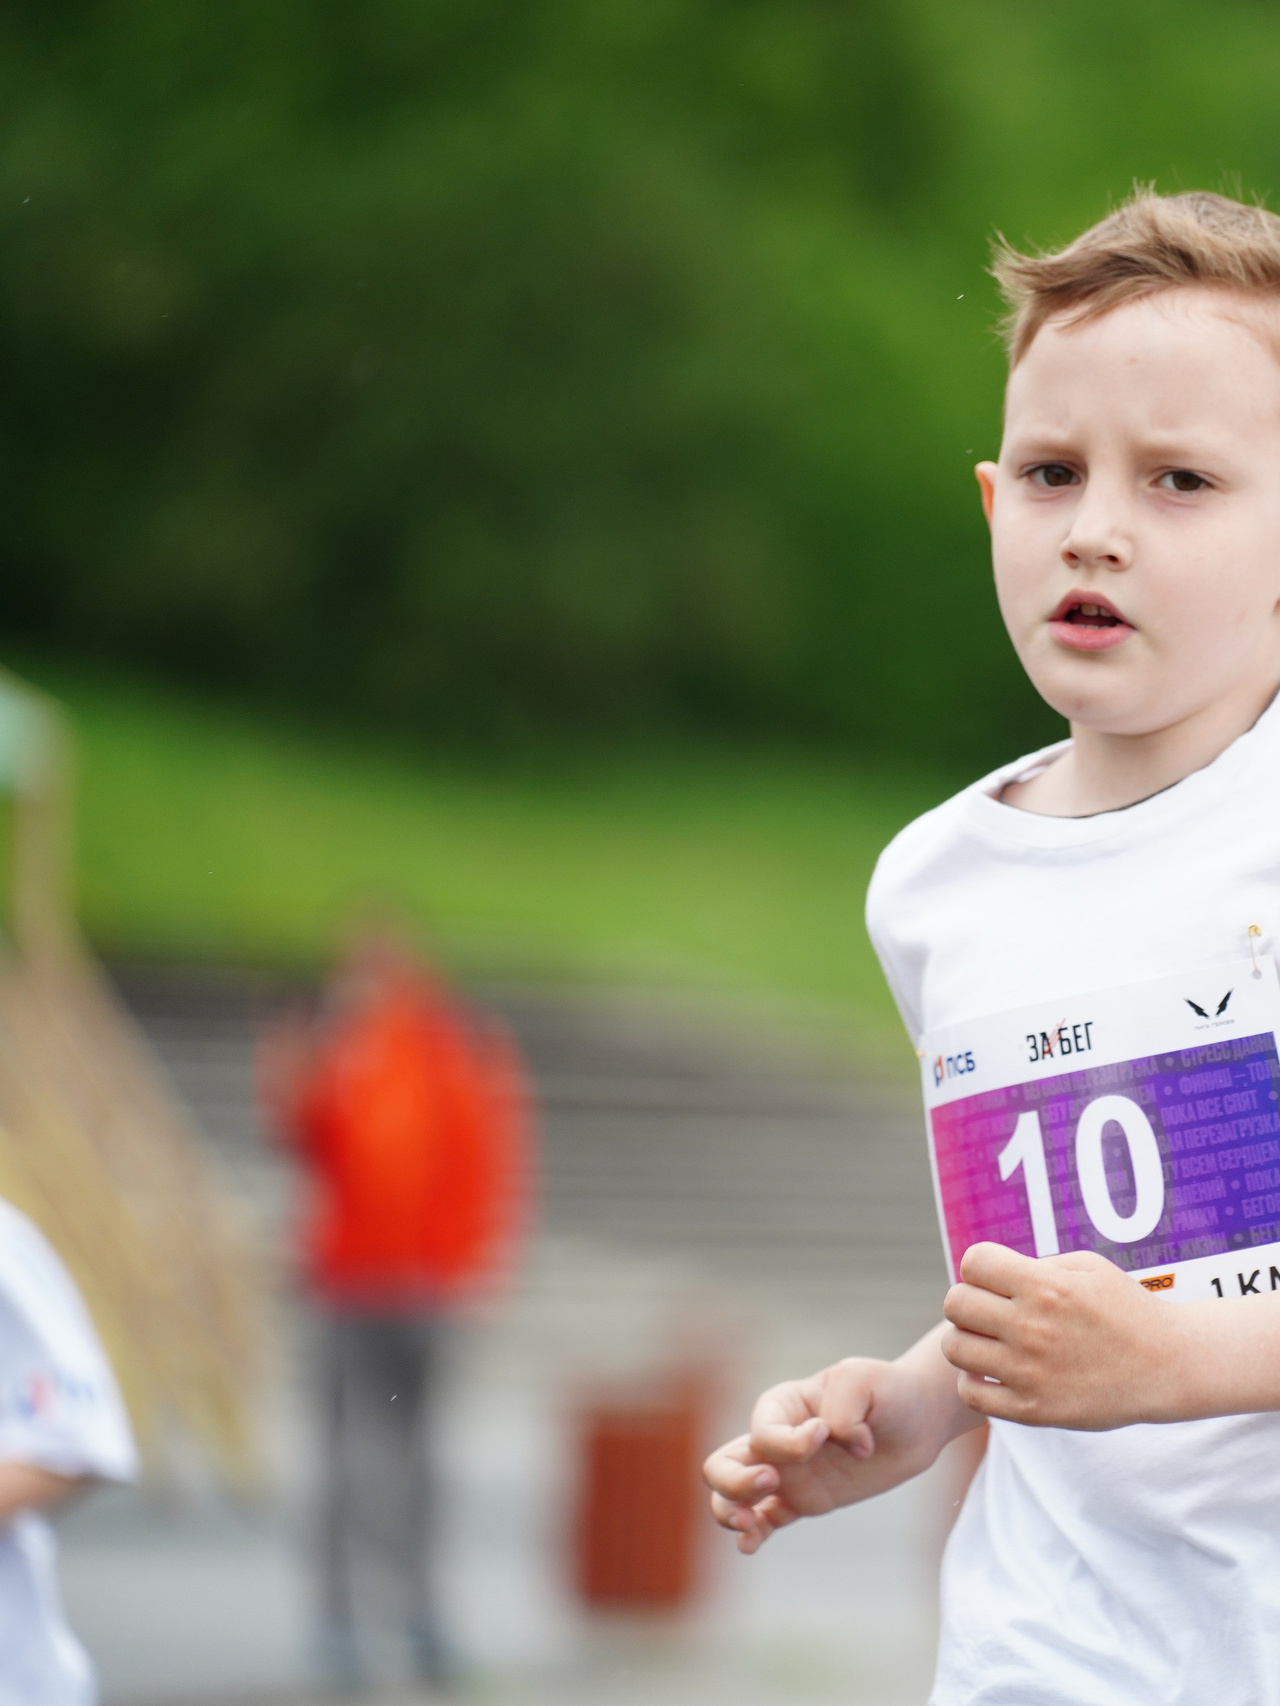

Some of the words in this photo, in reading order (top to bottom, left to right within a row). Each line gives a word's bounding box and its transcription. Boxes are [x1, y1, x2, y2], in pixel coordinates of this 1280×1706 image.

[946, 1051, 976, 1079] ПСБ
[1160, 1102, 1195, 1126] ПОКА
[1196, 1096, 1223, 1118] ВСЕ
[998, 1095, 1165, 1258] 10
[1211, 1277, 1224, 1298] 1
